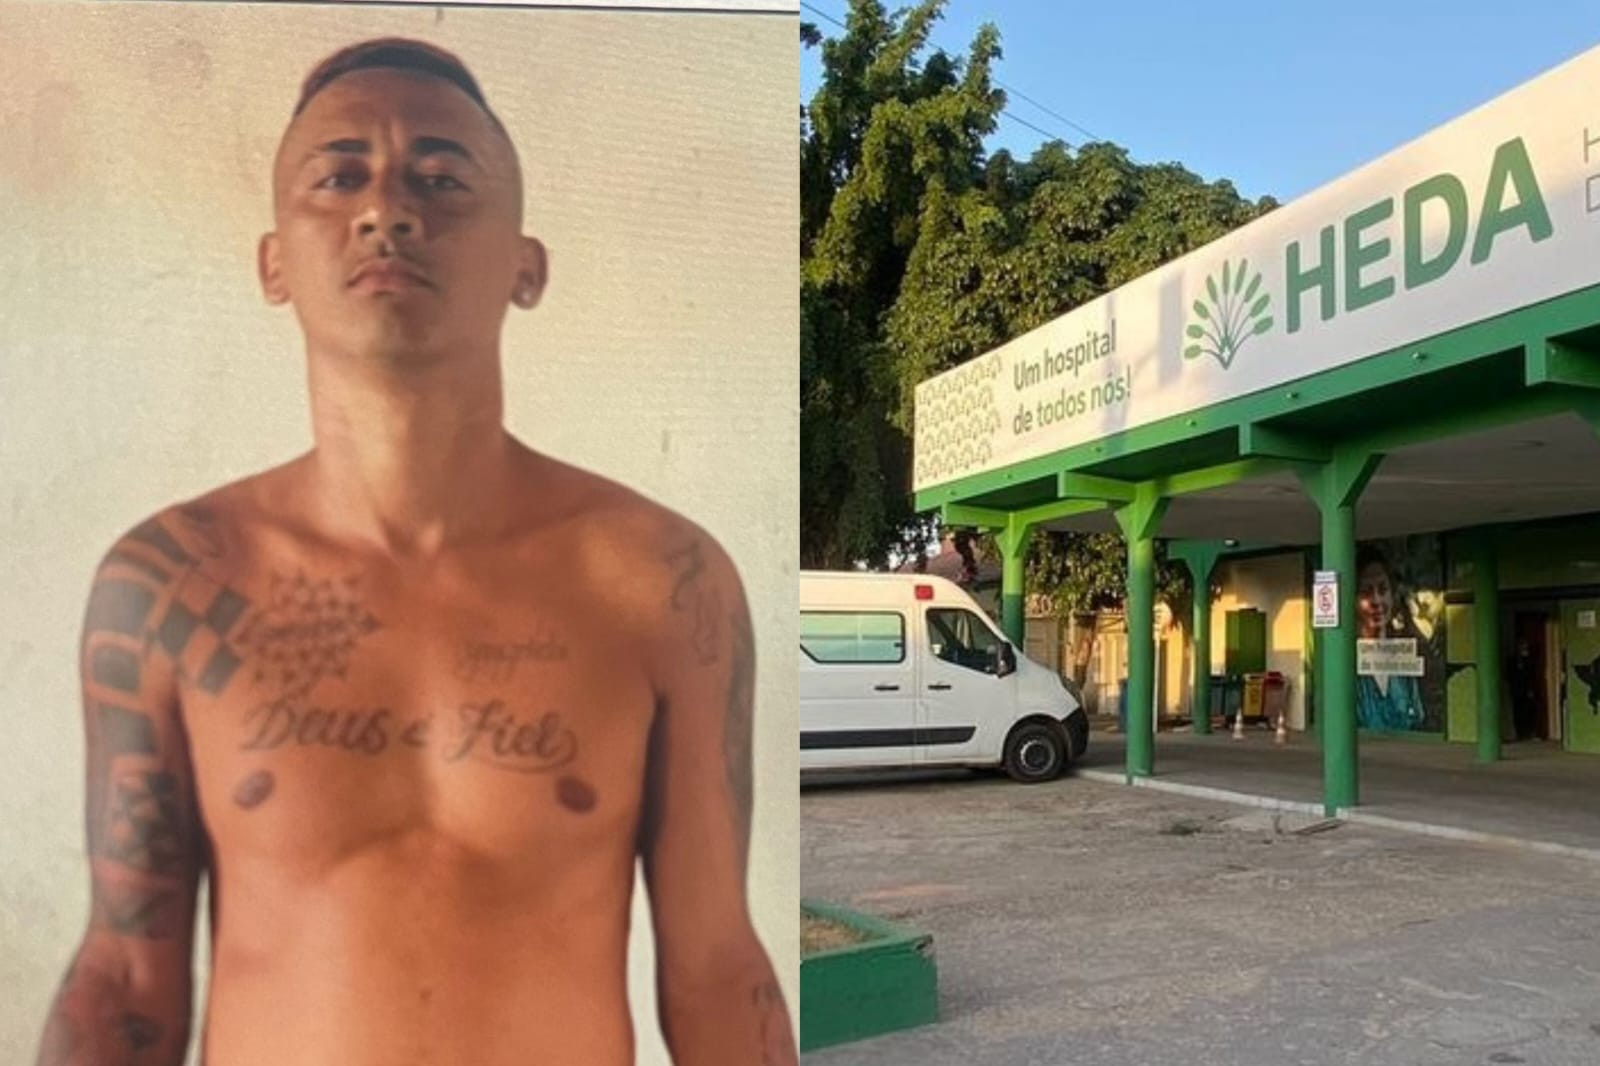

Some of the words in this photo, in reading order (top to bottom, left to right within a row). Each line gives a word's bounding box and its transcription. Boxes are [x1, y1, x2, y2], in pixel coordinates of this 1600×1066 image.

[1286, 137, 1553, 333] HEDA
[1014, 360, 1040, 391] Um
[1044, 318, 1116, 377] hospital
[1014, 403, 1033, 435] de
[1037, 388, 1086, 427] todos
[1091, 364, 1131, 410] nós!
[238, 696, 391, 755] Deus
[446, 698, 579, 774] Fiel
